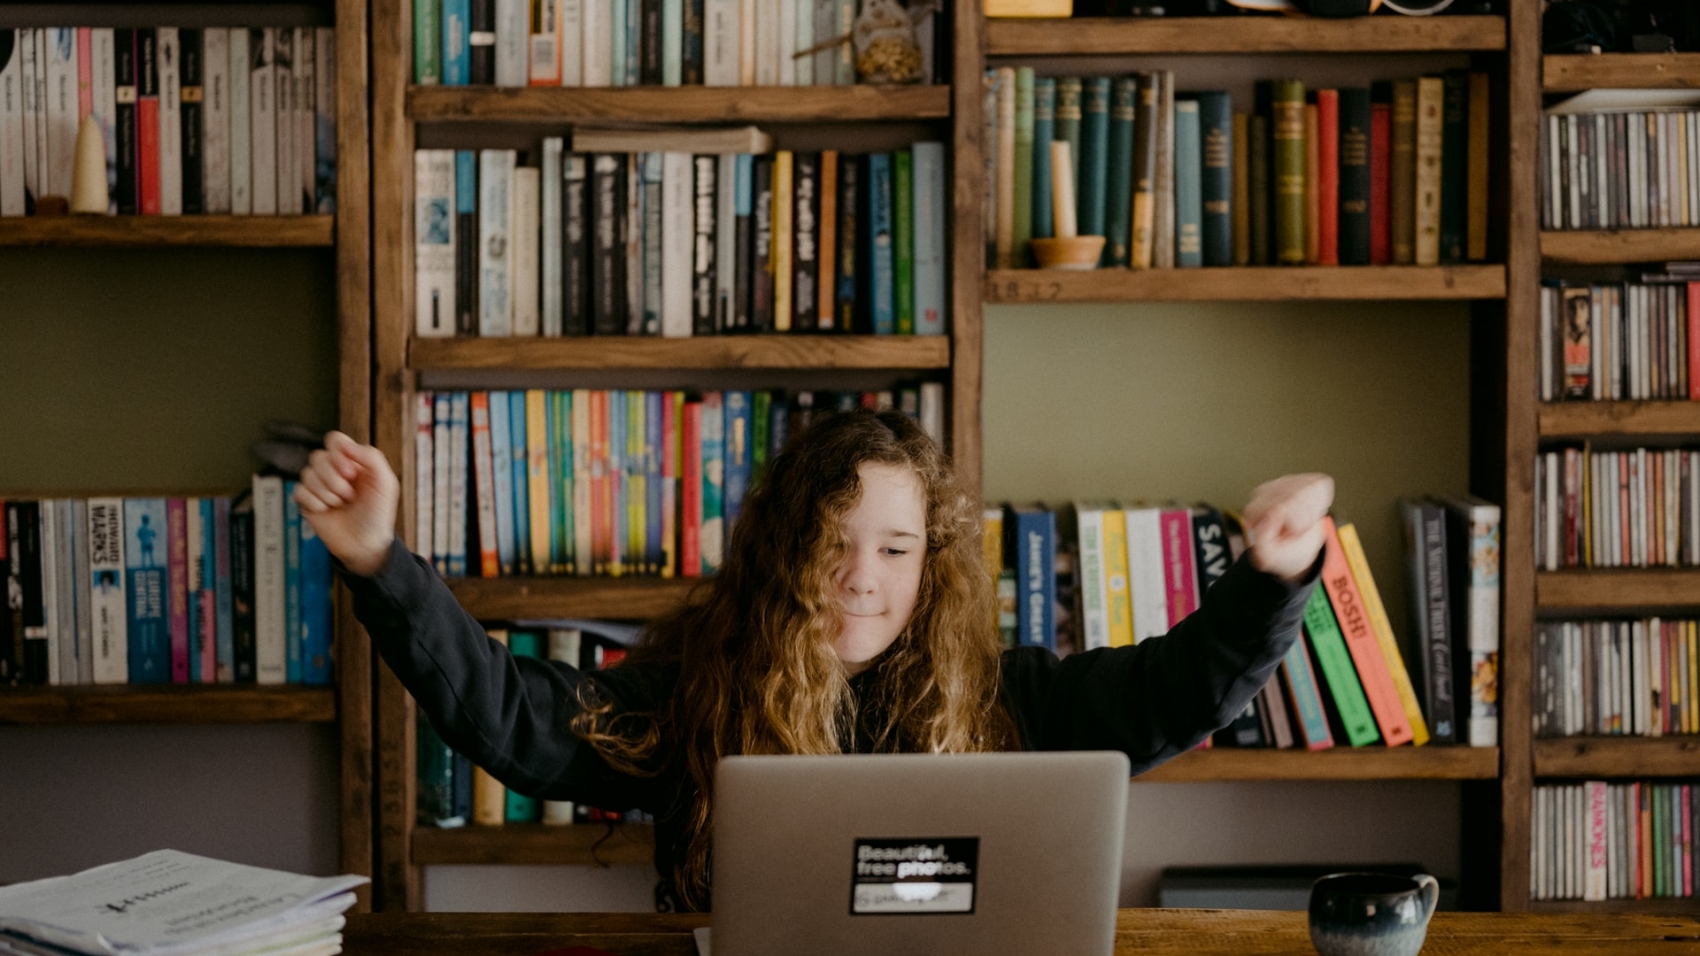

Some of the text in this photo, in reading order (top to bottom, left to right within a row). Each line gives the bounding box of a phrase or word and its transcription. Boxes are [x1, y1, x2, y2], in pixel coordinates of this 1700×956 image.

[1199, 524, 1227, 588] SAV
[1029, 592, 1044, 643] GREAT
[1332, 575, 1367, 638] BOSH!
[858, 845, 949, 861] Beautiful,
[1591, 783, 1606, 868] RAMONES
[857, 861, 971, 879] free photos.
